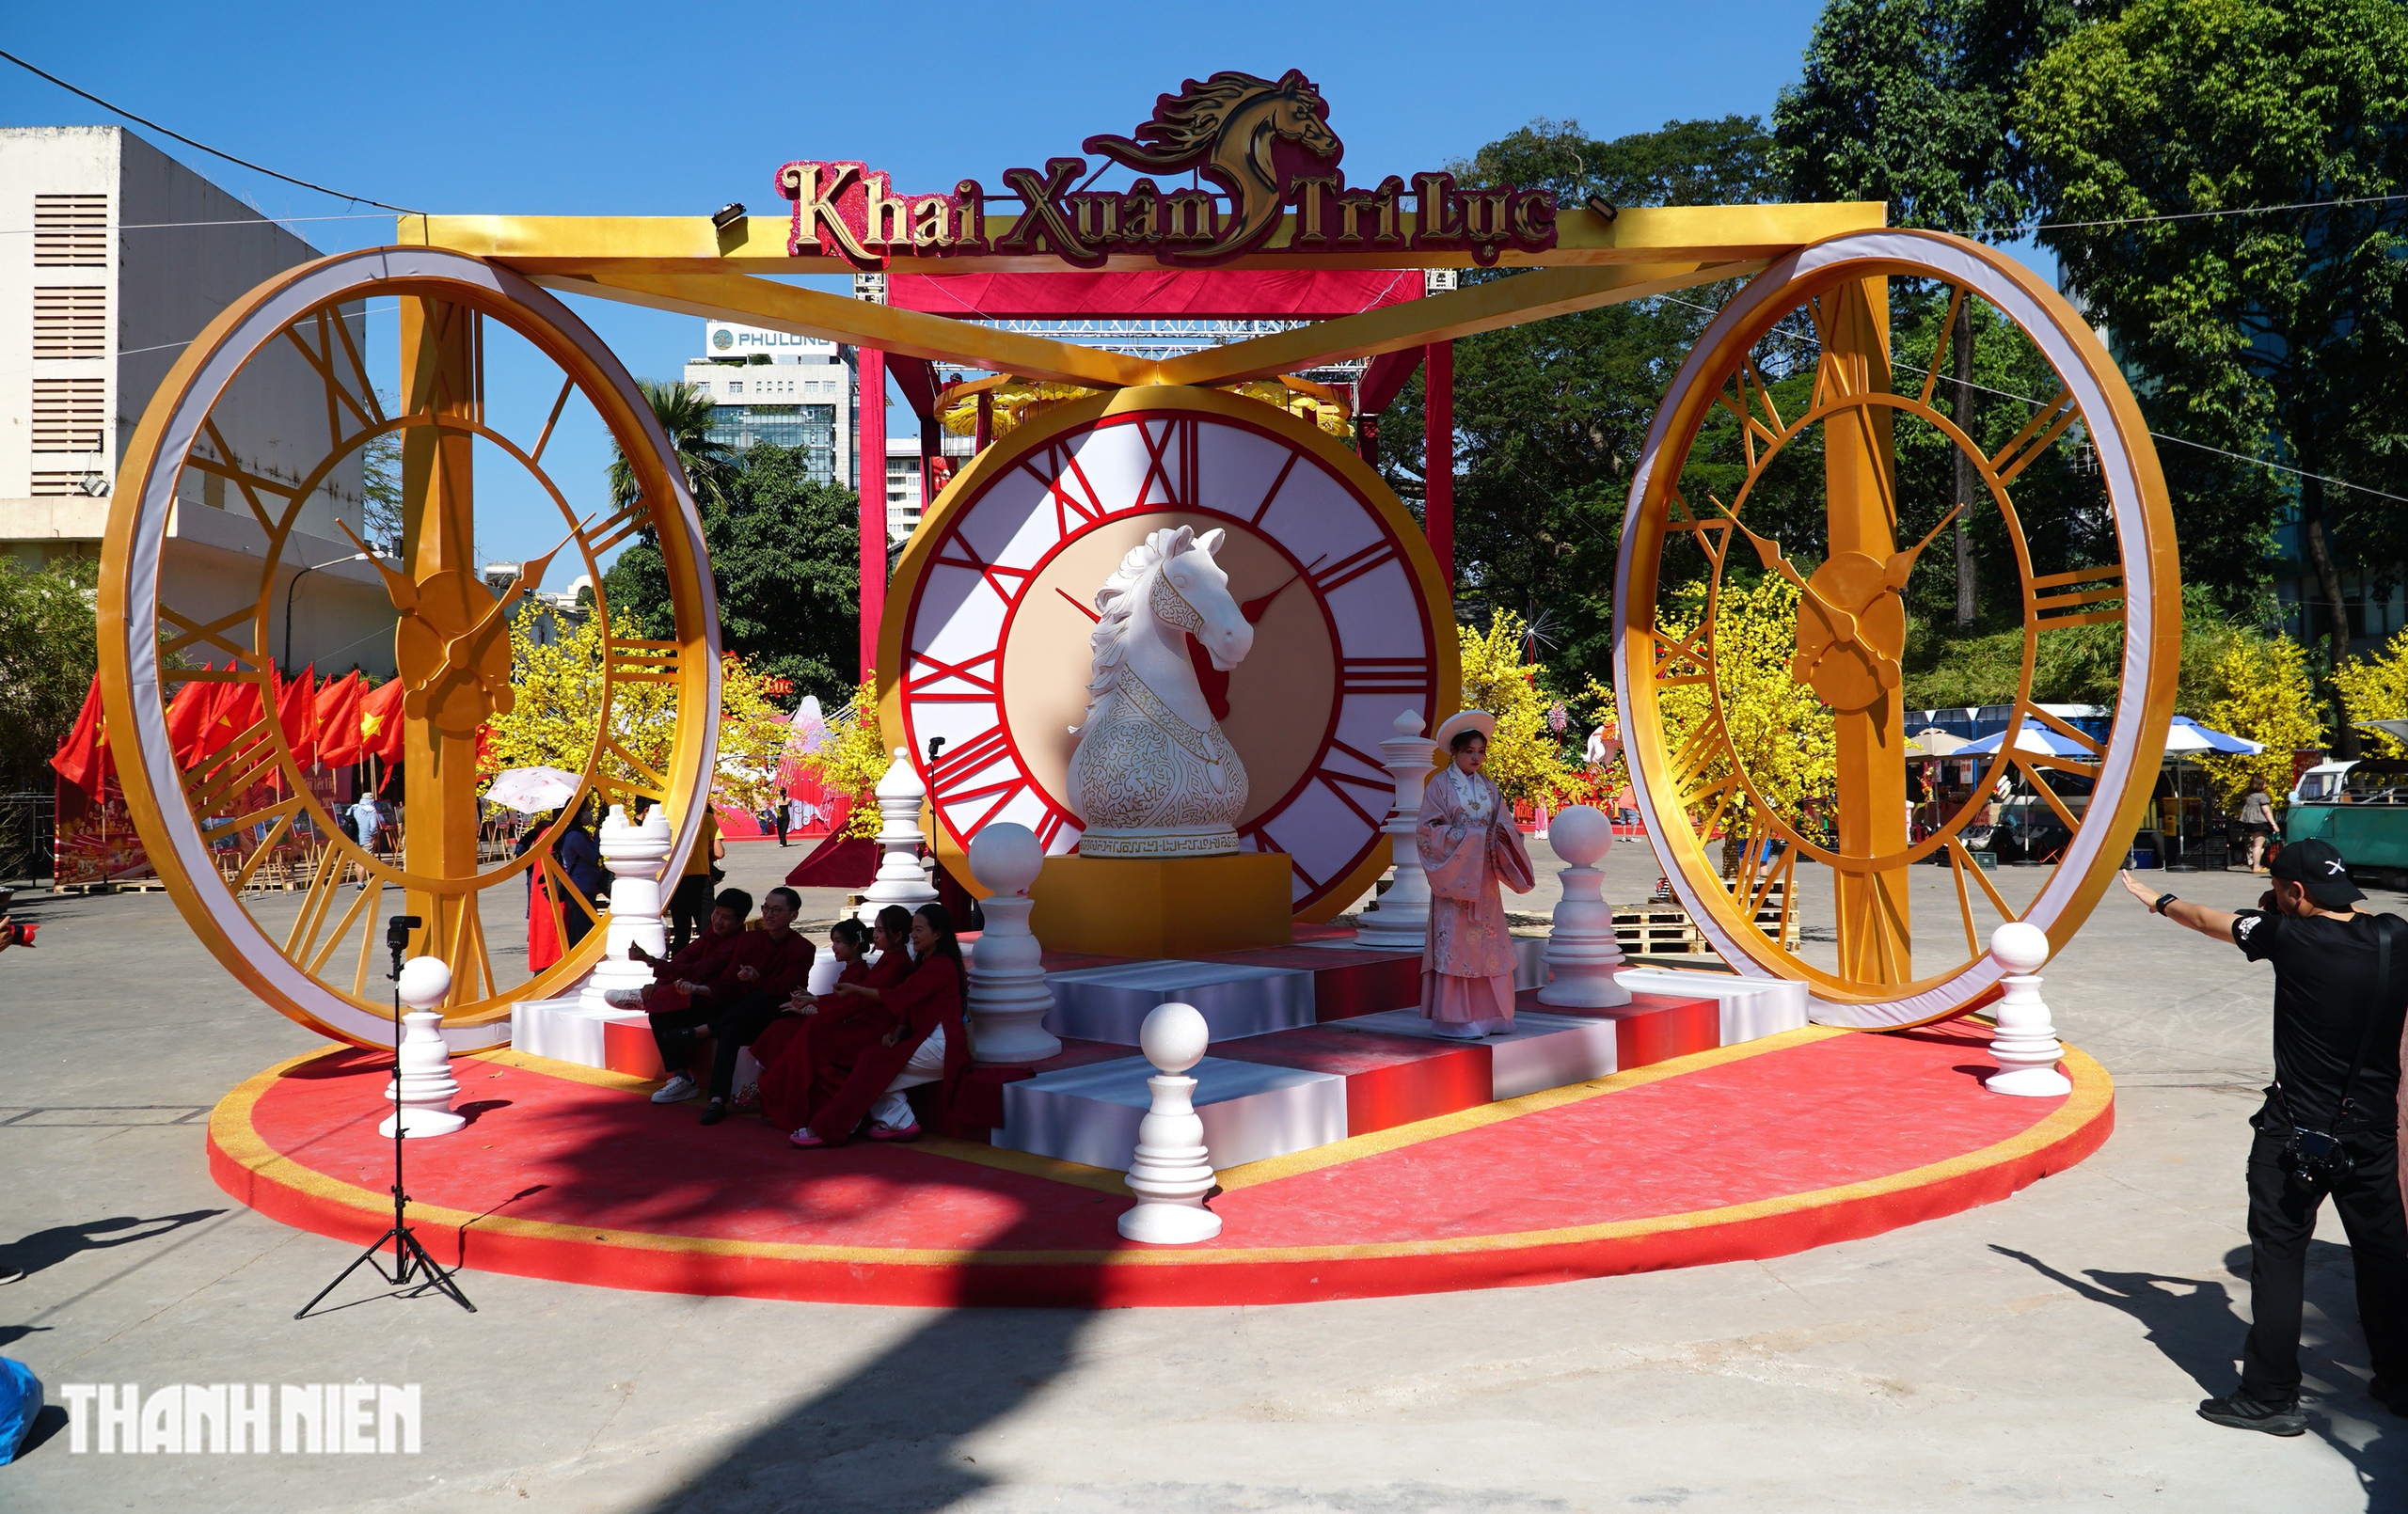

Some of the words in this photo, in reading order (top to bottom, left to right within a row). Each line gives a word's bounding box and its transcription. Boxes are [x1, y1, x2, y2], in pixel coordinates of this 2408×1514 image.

[782, 165, 981, 260] Khai
[1001, 162, 1216, 259] Xuân
[1290, 173, 1402, 243] Trí
